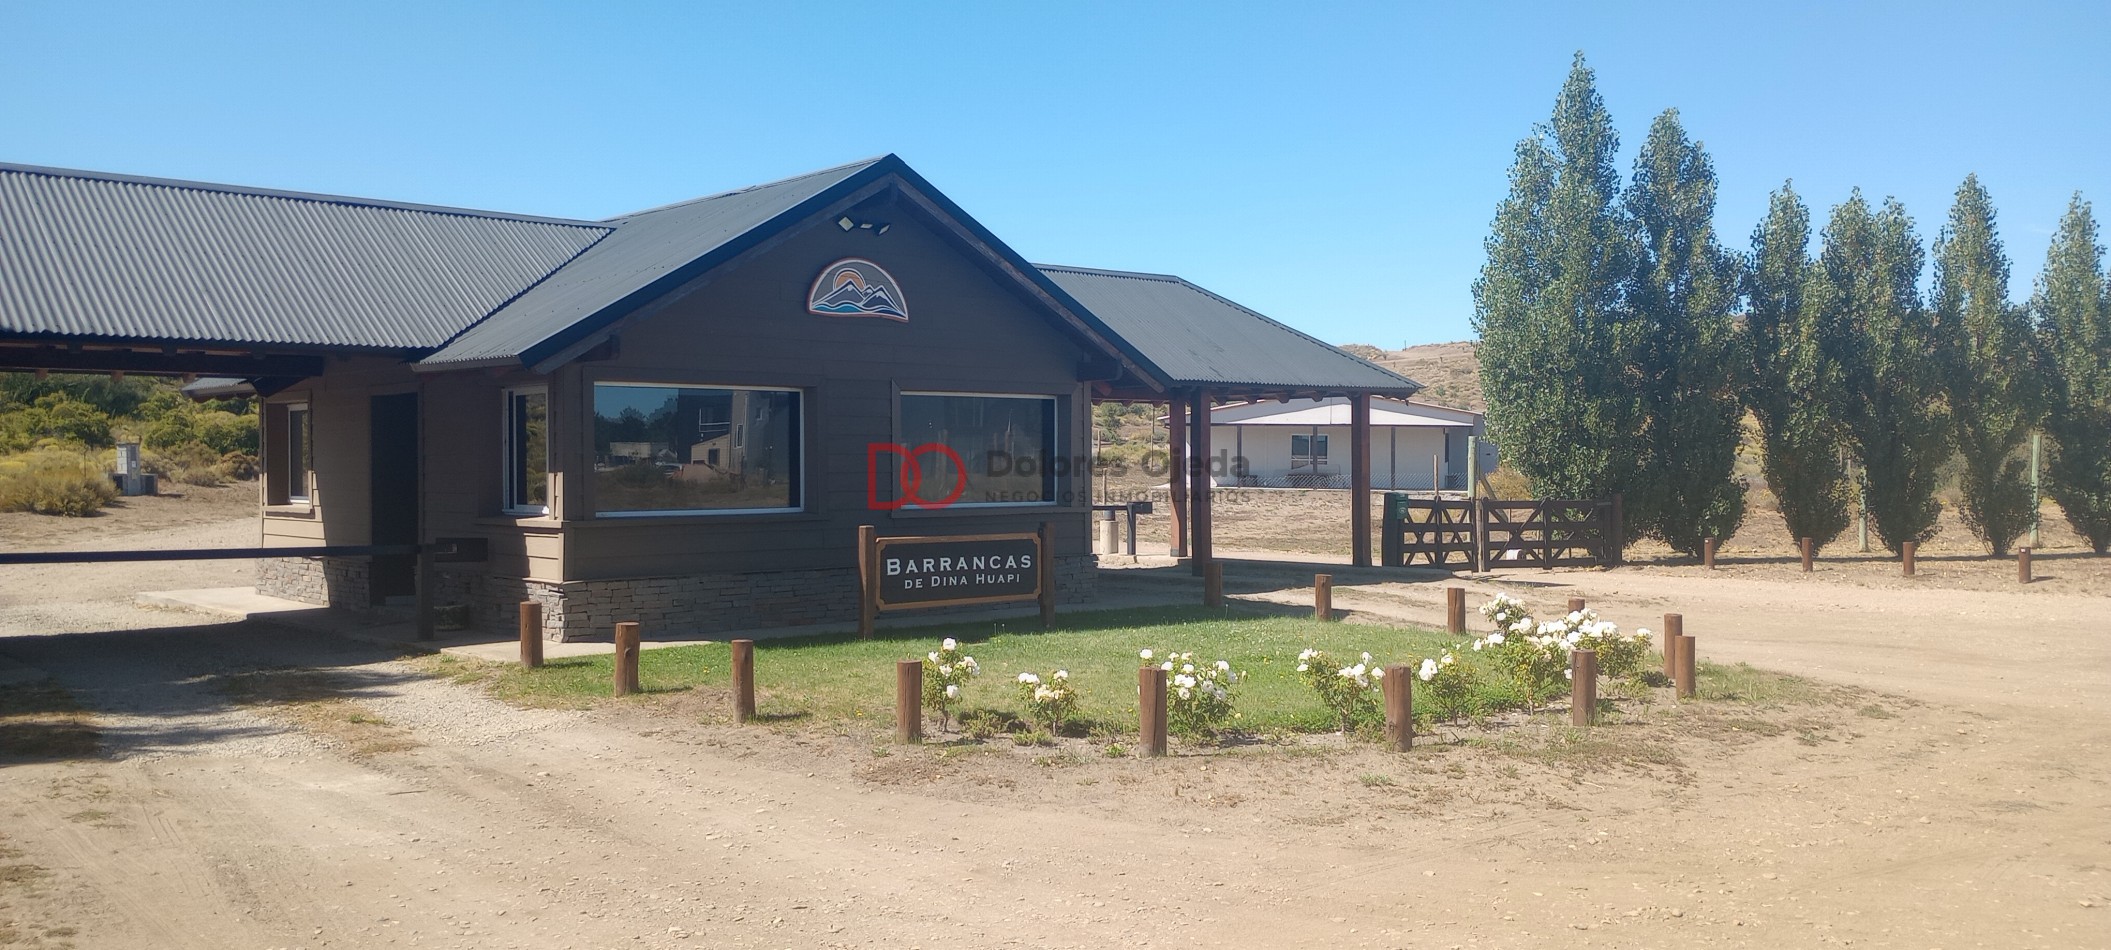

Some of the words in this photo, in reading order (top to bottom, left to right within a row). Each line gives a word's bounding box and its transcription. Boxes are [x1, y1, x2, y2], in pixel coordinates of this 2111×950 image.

[886, 554, 1032, 576] BARRANCAS
[904, 576, 924, 589] DE
[930, 574, 968, 588] DINA
[975, 572, 1021, 584] HUAPI
